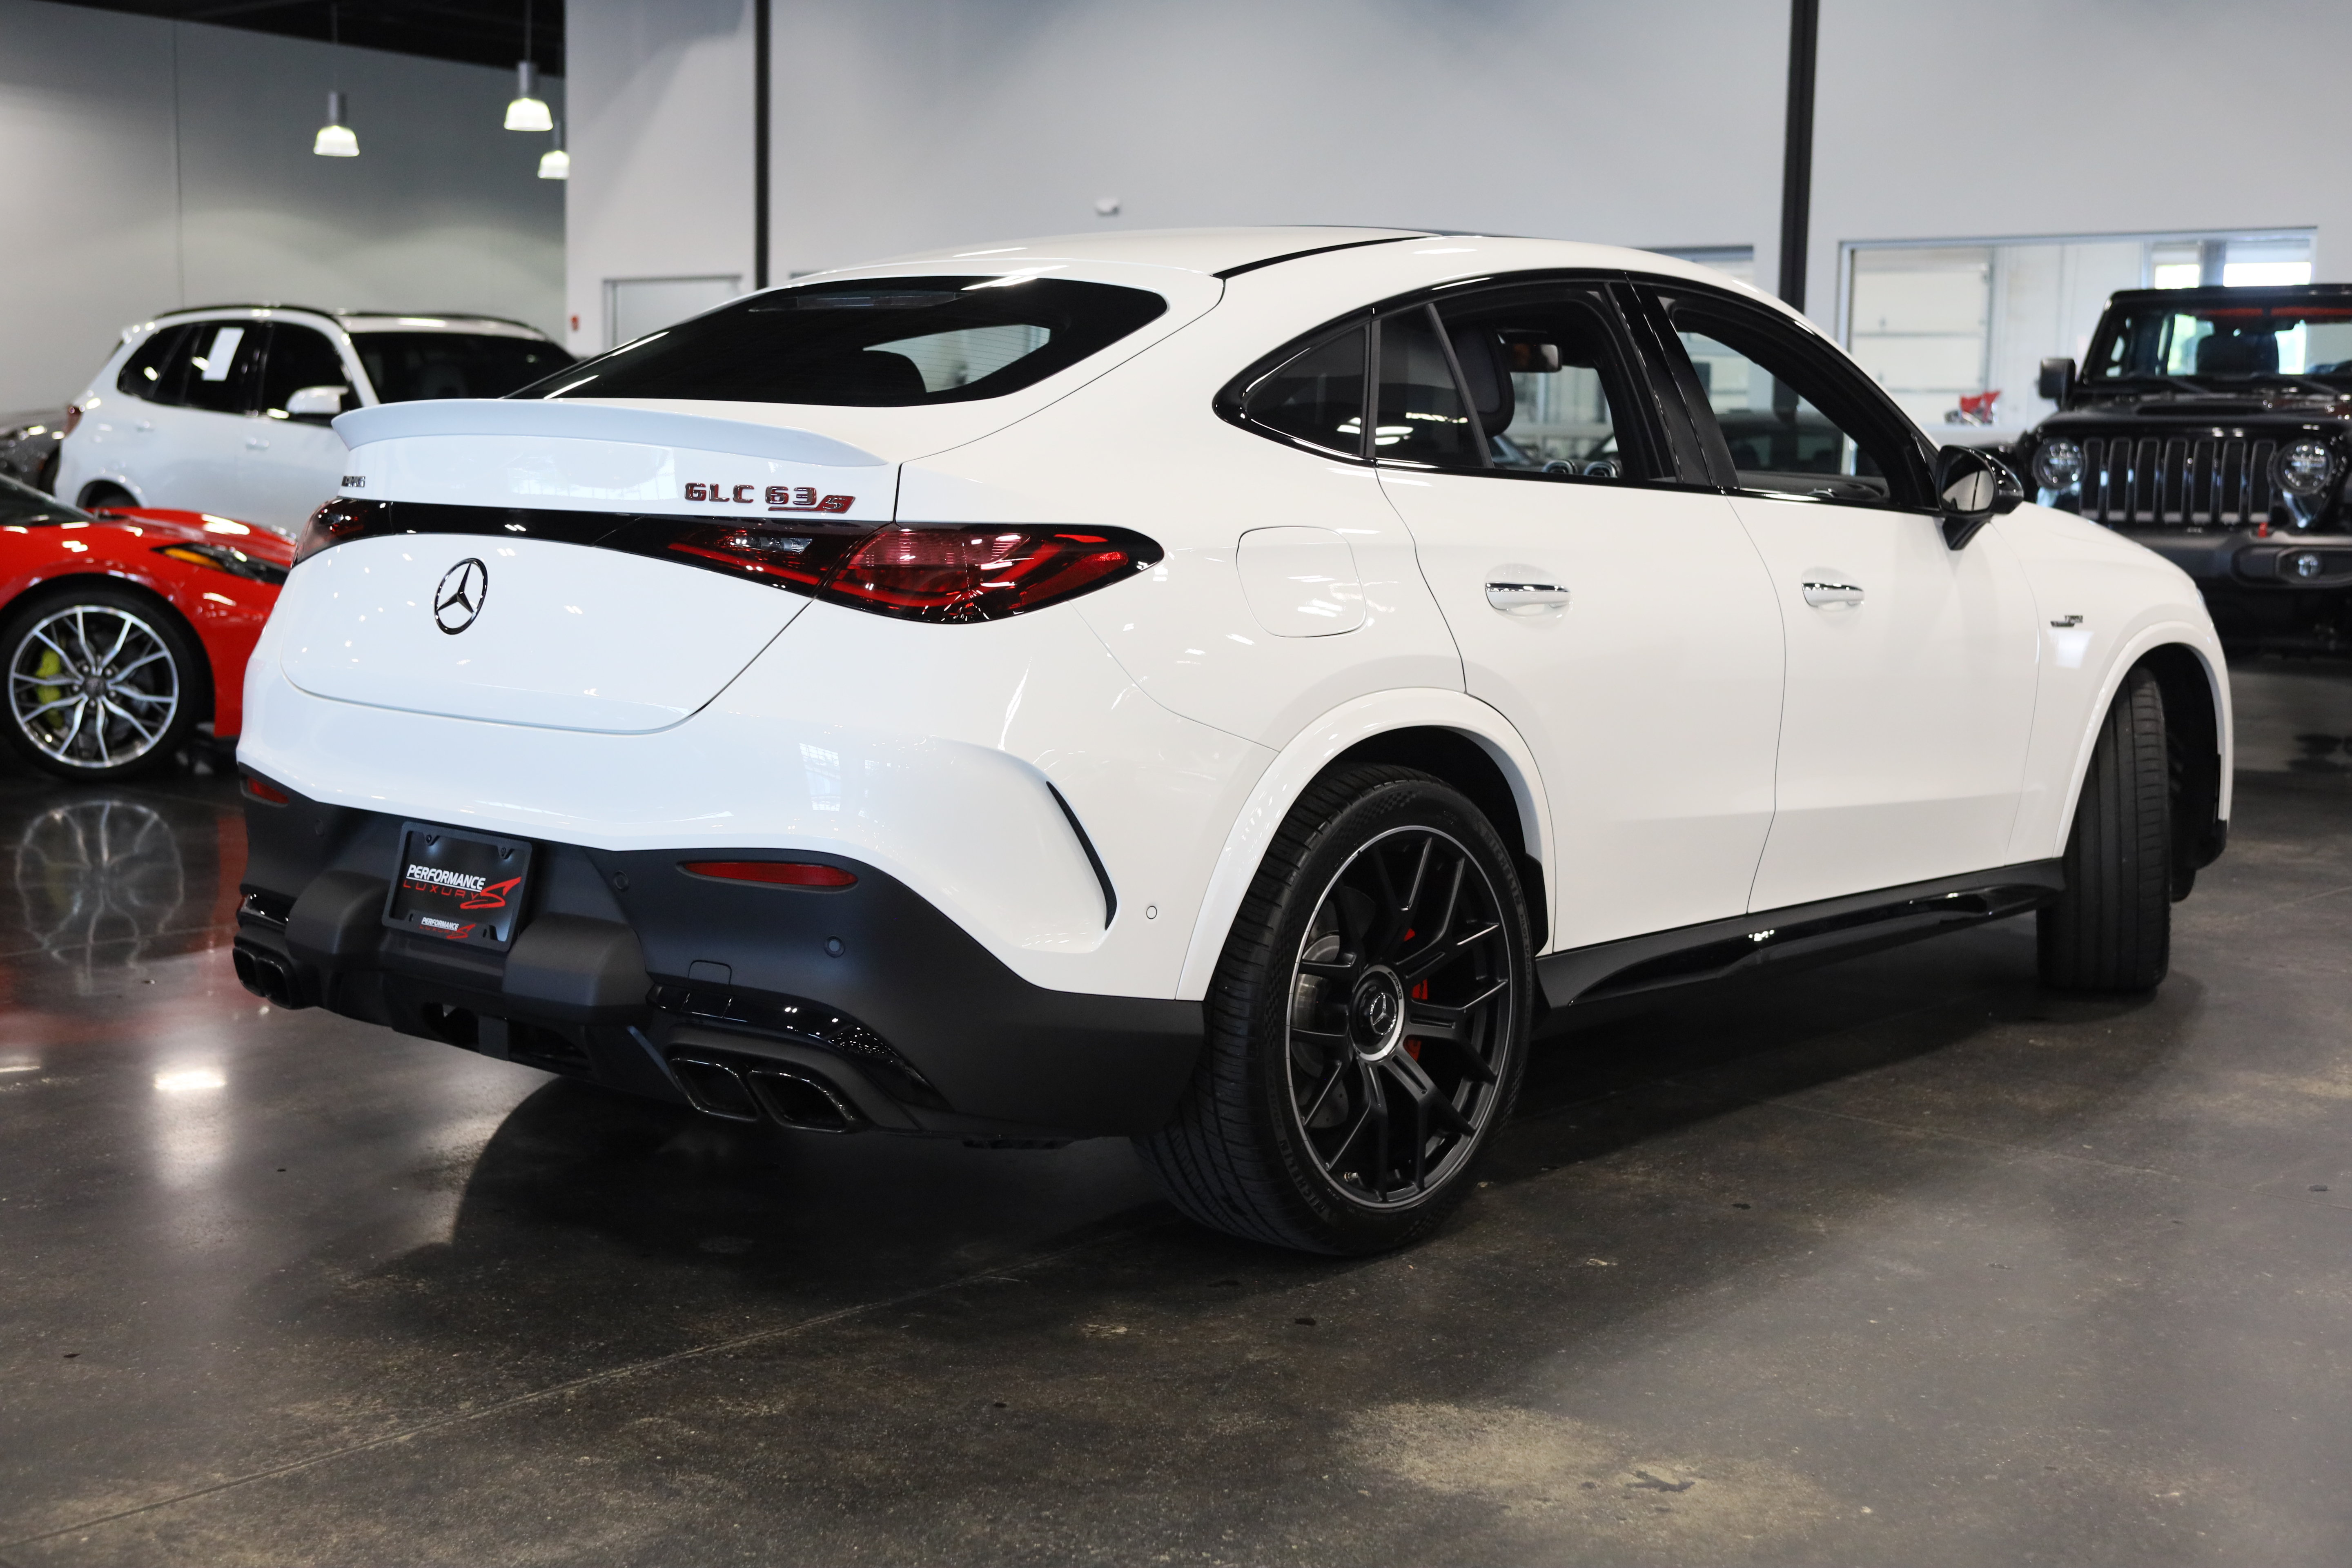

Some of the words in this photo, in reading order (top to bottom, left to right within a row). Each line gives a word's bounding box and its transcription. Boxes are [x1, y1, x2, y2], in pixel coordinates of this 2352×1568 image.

[685, 482, 755, 503] GLC
[765, 486, 817, 506] 63
[407, 864, 486, 890] PERFORMANCE
[403, 880, 479, 900] LUXURY
[421, 917, 459, 931] PERFORMANCE
[1279, 1138, 1325, 1214] MICHELIN
